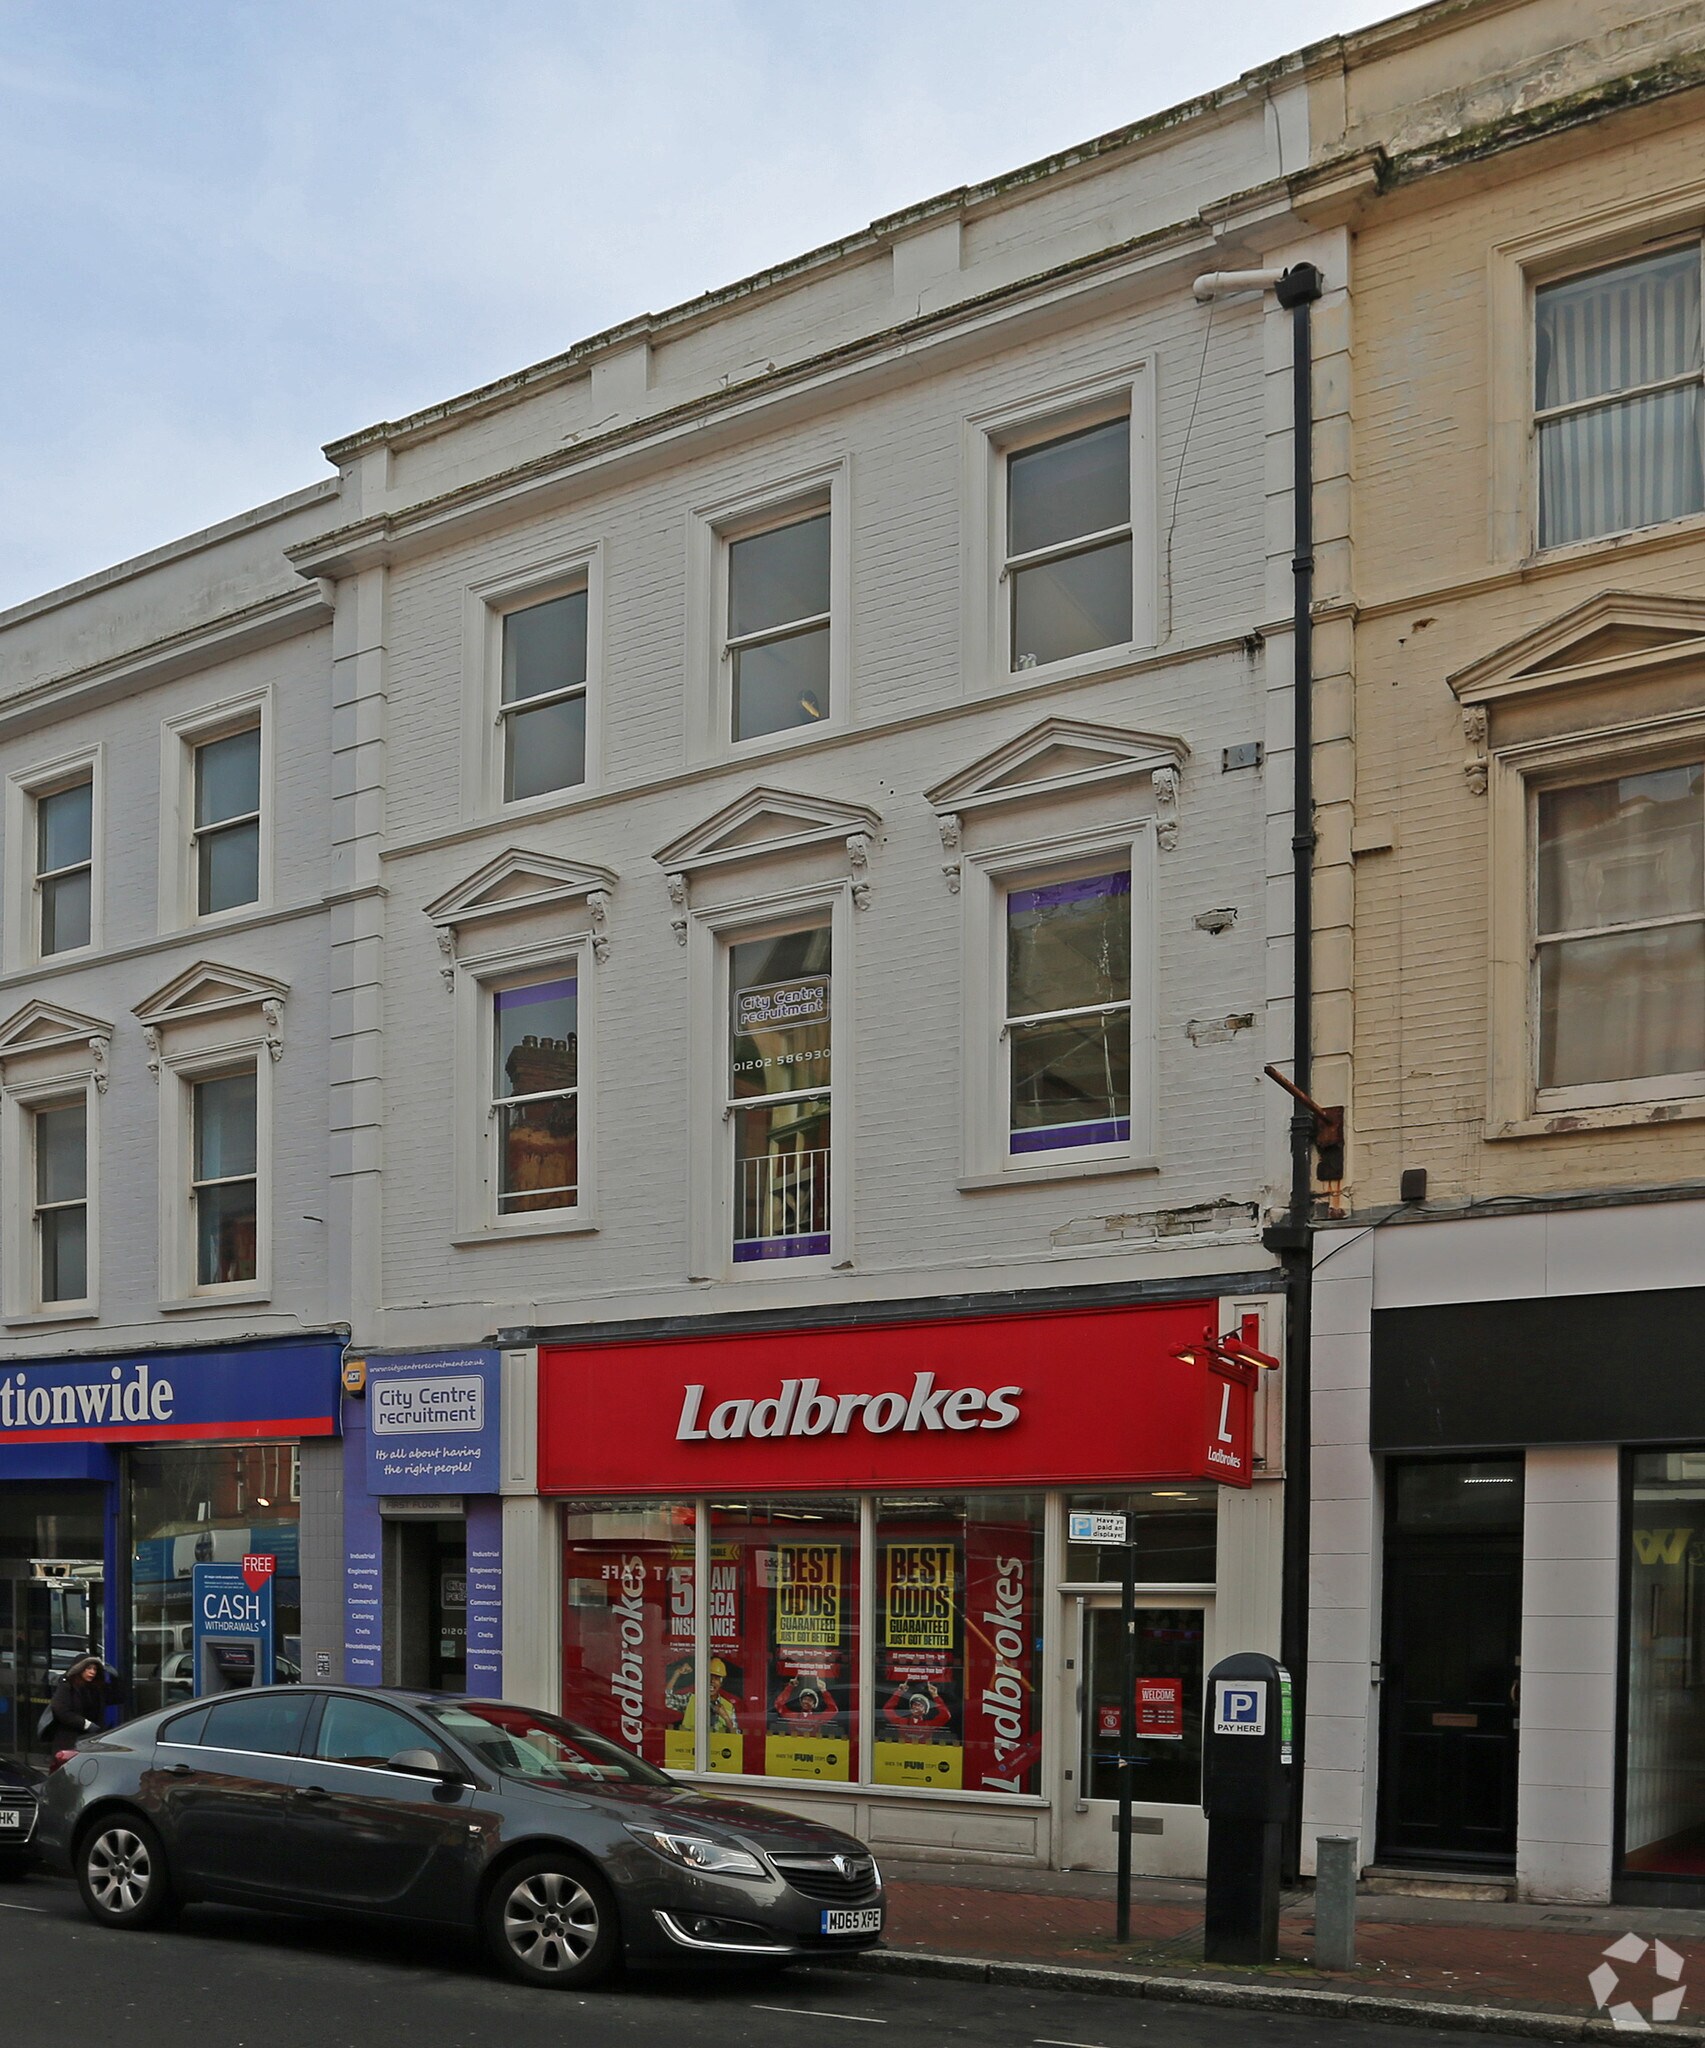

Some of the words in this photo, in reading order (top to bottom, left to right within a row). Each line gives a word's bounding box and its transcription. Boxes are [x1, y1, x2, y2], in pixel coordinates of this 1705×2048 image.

[741, 996, 770, 1010] City
[773, 986, 823, 1005] Centre
[741, 999, 823, 1024] recruitment
[733, 1057, 772, 1071] 01202
[776, 1048, 831, 1065] 586930
[0, 1365, 173, 1427] tionwide
[379, 1390, 412, 1409] City
[419, 1387, 476, 1404] Centre
[675, 1371, 1024, 1441] Ladbrokes
[379, 1405, 476, 1425] recruitment
[390, 1449, 407, 1459] all
[408, 1447, 440, 1459] about
[443, 1446, 481, 1459] having
[1208, 1445, 1241, 1469] Ladbrokes
[383, 1464, 403, 1475] the
[404, 1463, 432, 1476] right
[434, 1462, 472, 1475] people!
[412, 1501, 441, 1509] FLOOR
[243, 1557, 272, 1572] FREE
[781, 1548, 838, 1583] BEST
[891, 1548, 950, 1584] BEST
[671, 1566, 694, 1615] 5
[780, 1584, 837, 1617] ODDS
[203, 1594, 260, 1620] CASH
[890, 1585, 950, 1618] ODDS
[205, 1621, 259, 1632] WITHDRAWALS
[671, 1617, 736, 1637] INSUNCE
[780, 1617, 836, 1631] GUARANTEED
[890, 1619, 949, 1634] GUARANTEED
[345, 1643, 381, 1651] Housekeeping
[780, 1631, 795, 1642] JUST
[797, 1632, 810, 1642] GOT
[811, 1632, 836, 1643] BETTER
[890, 1634, 906, 1645] JUST
[908, 1634, 921, 1645] GOT
[923, 1635, 949, 1646] BETTER
[352, 1658, 374, 1666] Cleaning
[612, 1554, 646, 1759] adbrokes
[1142, 1689, 1175, 1700] WELCOME
[1230, 1694, 1253, 1720] P
[1217, 1724, 1234, 1732] PAY
[1237, 1725, 1262, 1733] HERE
[794, 1753, 814, 1762] FUN
[904, 1761, 924, 1770] FUN
[829, 1912, 859, 1930] MD65
